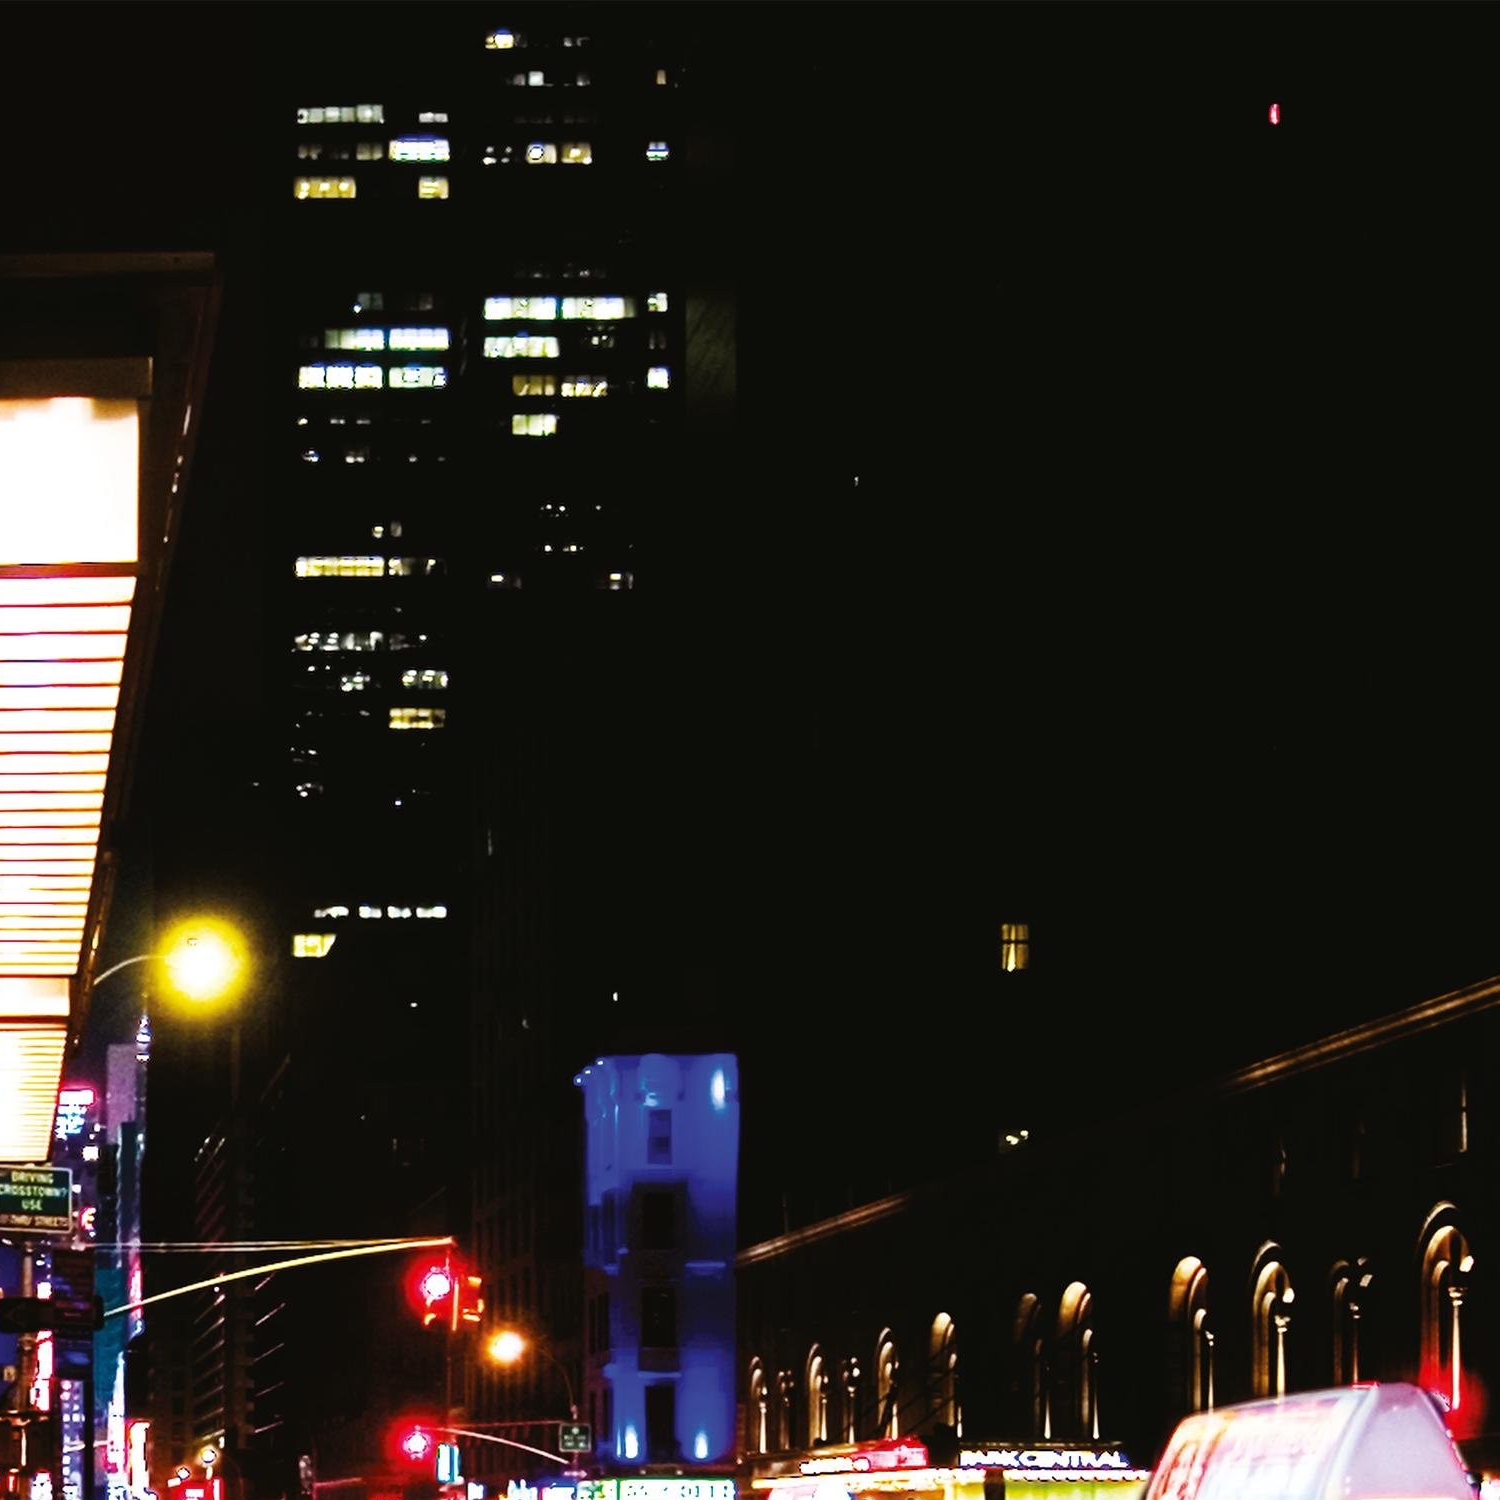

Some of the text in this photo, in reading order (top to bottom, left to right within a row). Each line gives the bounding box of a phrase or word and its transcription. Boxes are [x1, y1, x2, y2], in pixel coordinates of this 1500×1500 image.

[11, 1170, 54, 1185] DRIVING
[21, 1199, 43, 1211] USE
[960, 1449, 1018, 1468] PARK
